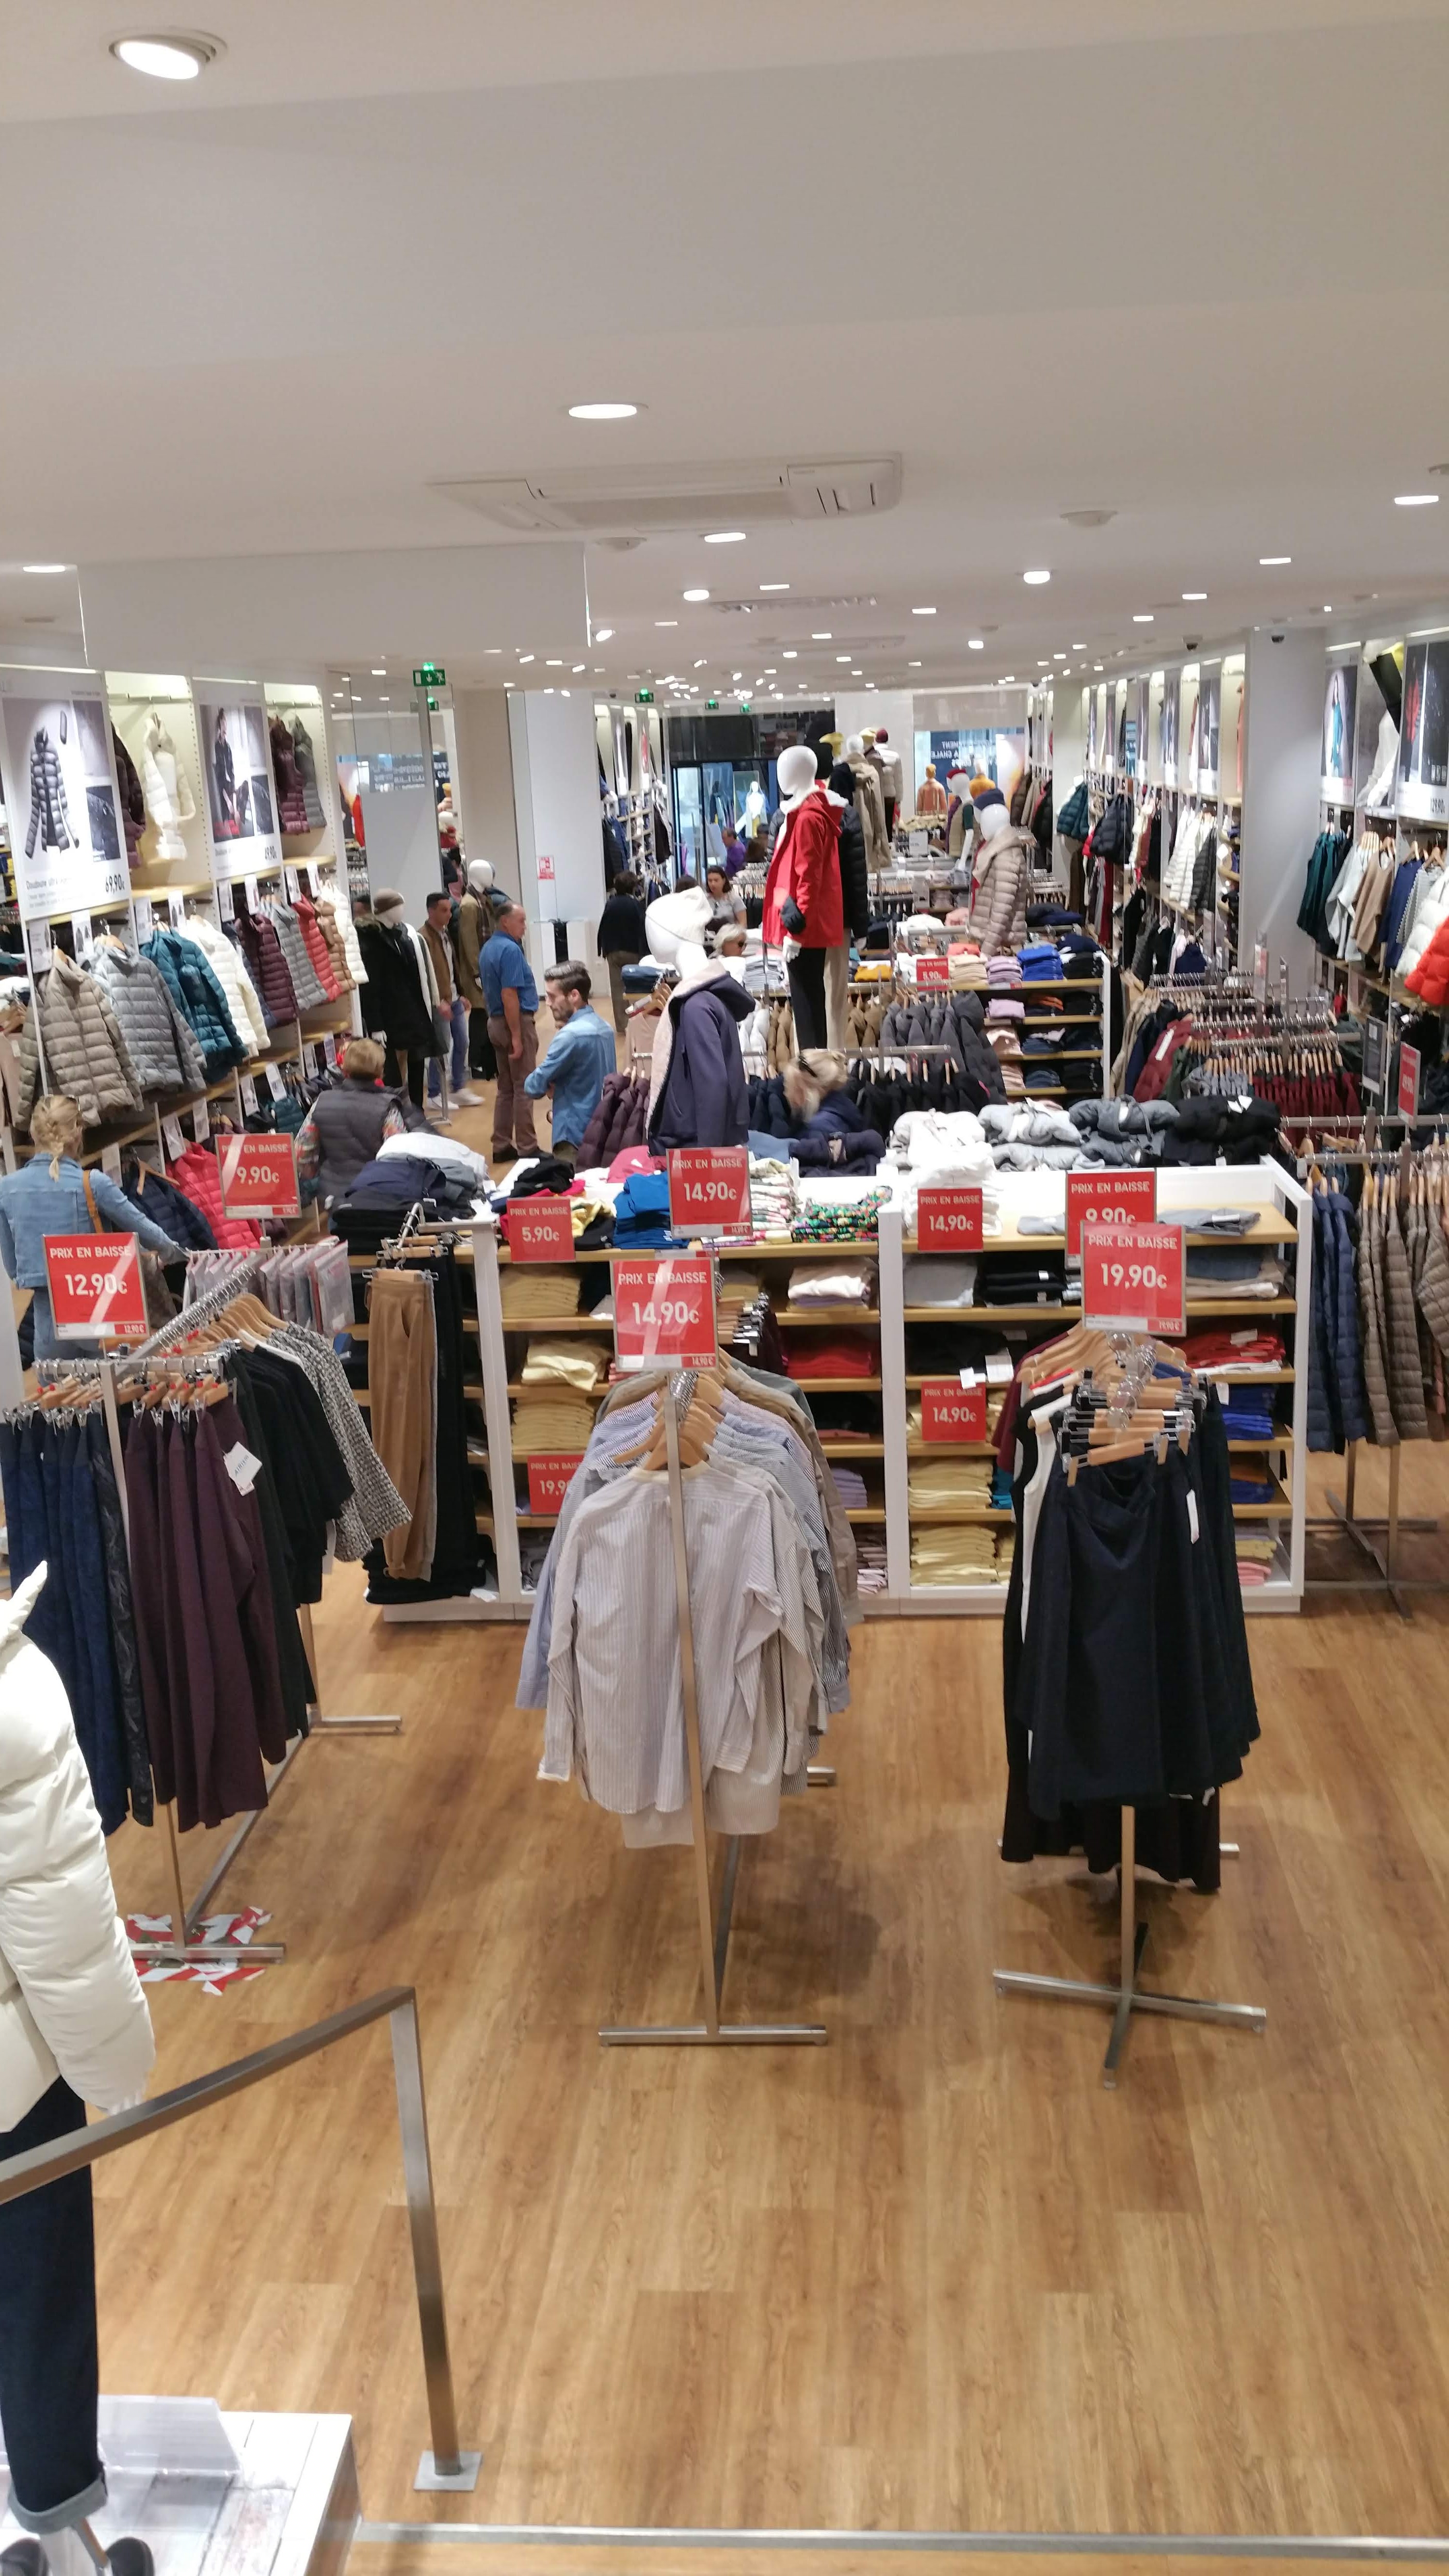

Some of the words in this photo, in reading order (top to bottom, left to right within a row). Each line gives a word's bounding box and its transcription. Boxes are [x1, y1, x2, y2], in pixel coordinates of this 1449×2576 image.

[105, 873, 125, 894] 69,90€
[244, 1144, 255, 1153] EN
[258, 1143, 289, 1153] BAISSE
[673, 1159, 692, 1169] PRIX
[695, 1159, 708, 1169] EN
[711, 1158, 743, 1169] BAISSE
[237, 1166, 280, 1185] 9,90€
[684, 1181, 737, 1203] 14,90€
[1071, 1183, 1093, 1194] PRIX
[1097, 1182, 1111, 1193] EN
[1114, 1181, 1150, 1193] BAISSE
[920, 1196, 937, 1205] PRIX
[940, 1195, 950, 1205] EN
[953, 1195, 980, 1204] BAISSE
[510, 1208, 527, 1216] PRIX
[529, 1207, 540, 1216] EN
[542, 1207, 568, 1215] BAISSE
[1085, 1207, 1136, 1223] 990€
[929, 1214, 974, 1233] 14,90€
[522, 1225, 560, 1243] 5,90€
[1089, 1235, 1113, 1247] PRIX
[1117, 1236, 1133, 1248] EN
[1137, 1237, 1178, 1250] BAISSE
[49, 1247, 74, 1259] PRIX
[76, 1246, 92, 1258] EN
[94, 1245, 132, 1257] BAISSE
[618, 1273, 644, 1285] PRIX
[647, 1272, 663, 1284] EN
[667, 1271, 707, 1284] BAISSE
[1101, 1263, 1167, 1290] 19,90€
[64, 1273, 128, 1298] 12,90€
[632, 1301, 700, 1327] 14,90€
[924, 1388, 941, 1397] PRIX
[944, 1388, 954, 1397] EN
[933, 1406, 977, 1424] 14,90€
[539, 1480, 569, 1496] 19,9
